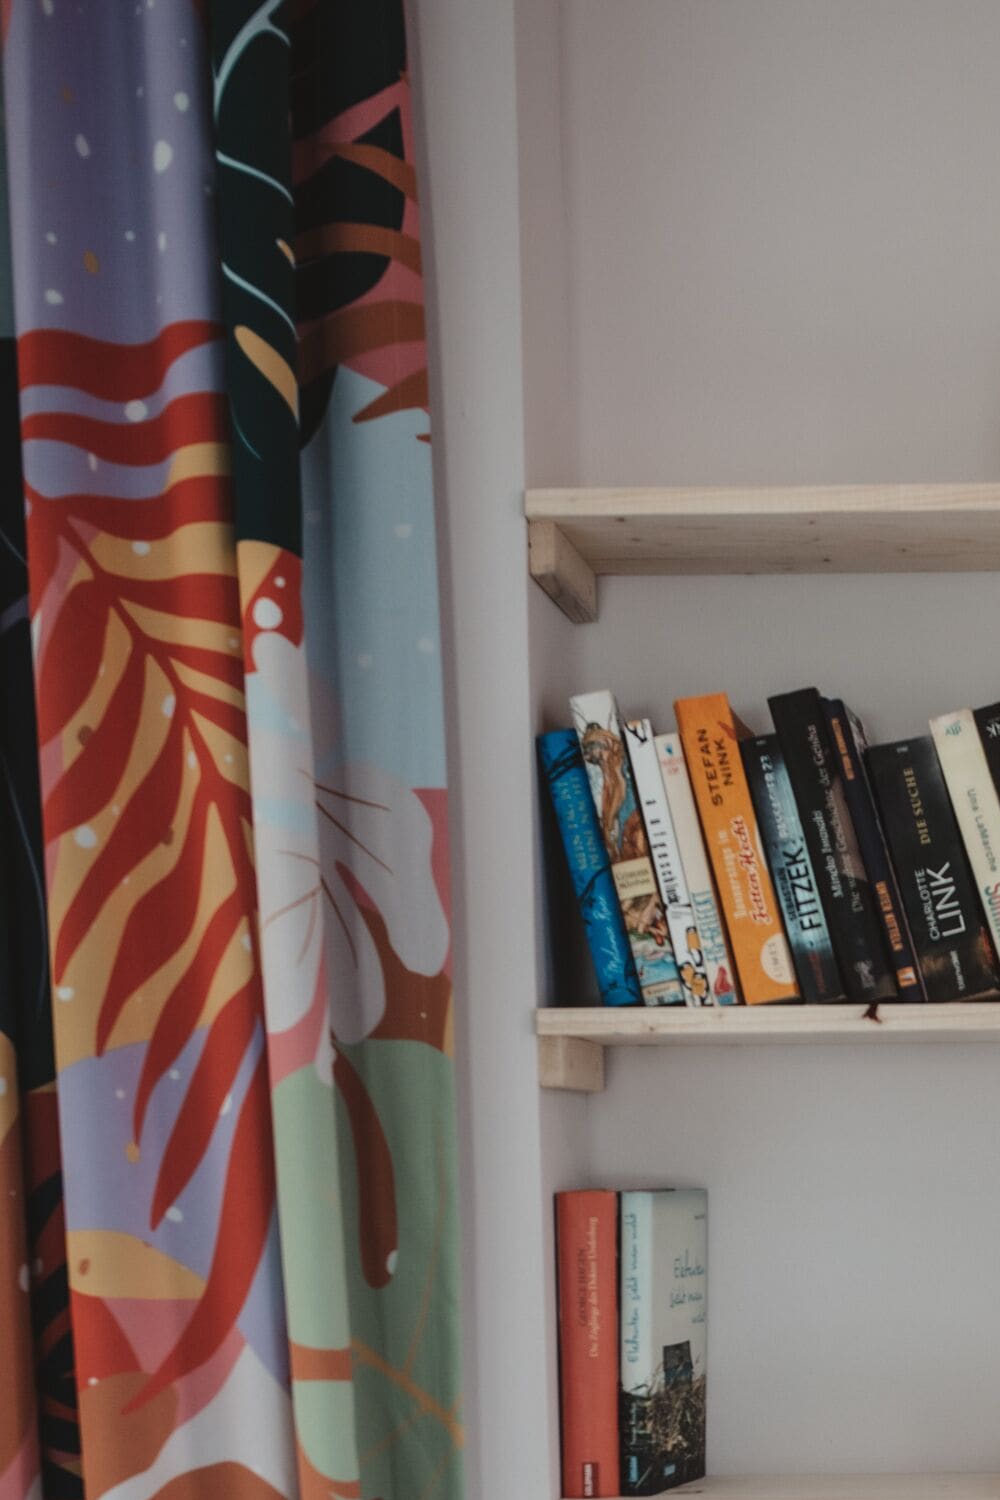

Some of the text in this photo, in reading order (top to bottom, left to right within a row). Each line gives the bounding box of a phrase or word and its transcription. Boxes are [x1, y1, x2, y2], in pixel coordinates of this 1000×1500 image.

[695, 726, 723, 807] STEFAN
[712, 736, 735, 787] NINK
[729, 814, 758, 871] Hecht
[901, 764, 931, 845] DIE SUCHE
[781, 844, 821, 932] FITZEK
[913, 866, 941, 942] CHARLOTTE
[925, 860, 967, 939] LINK
